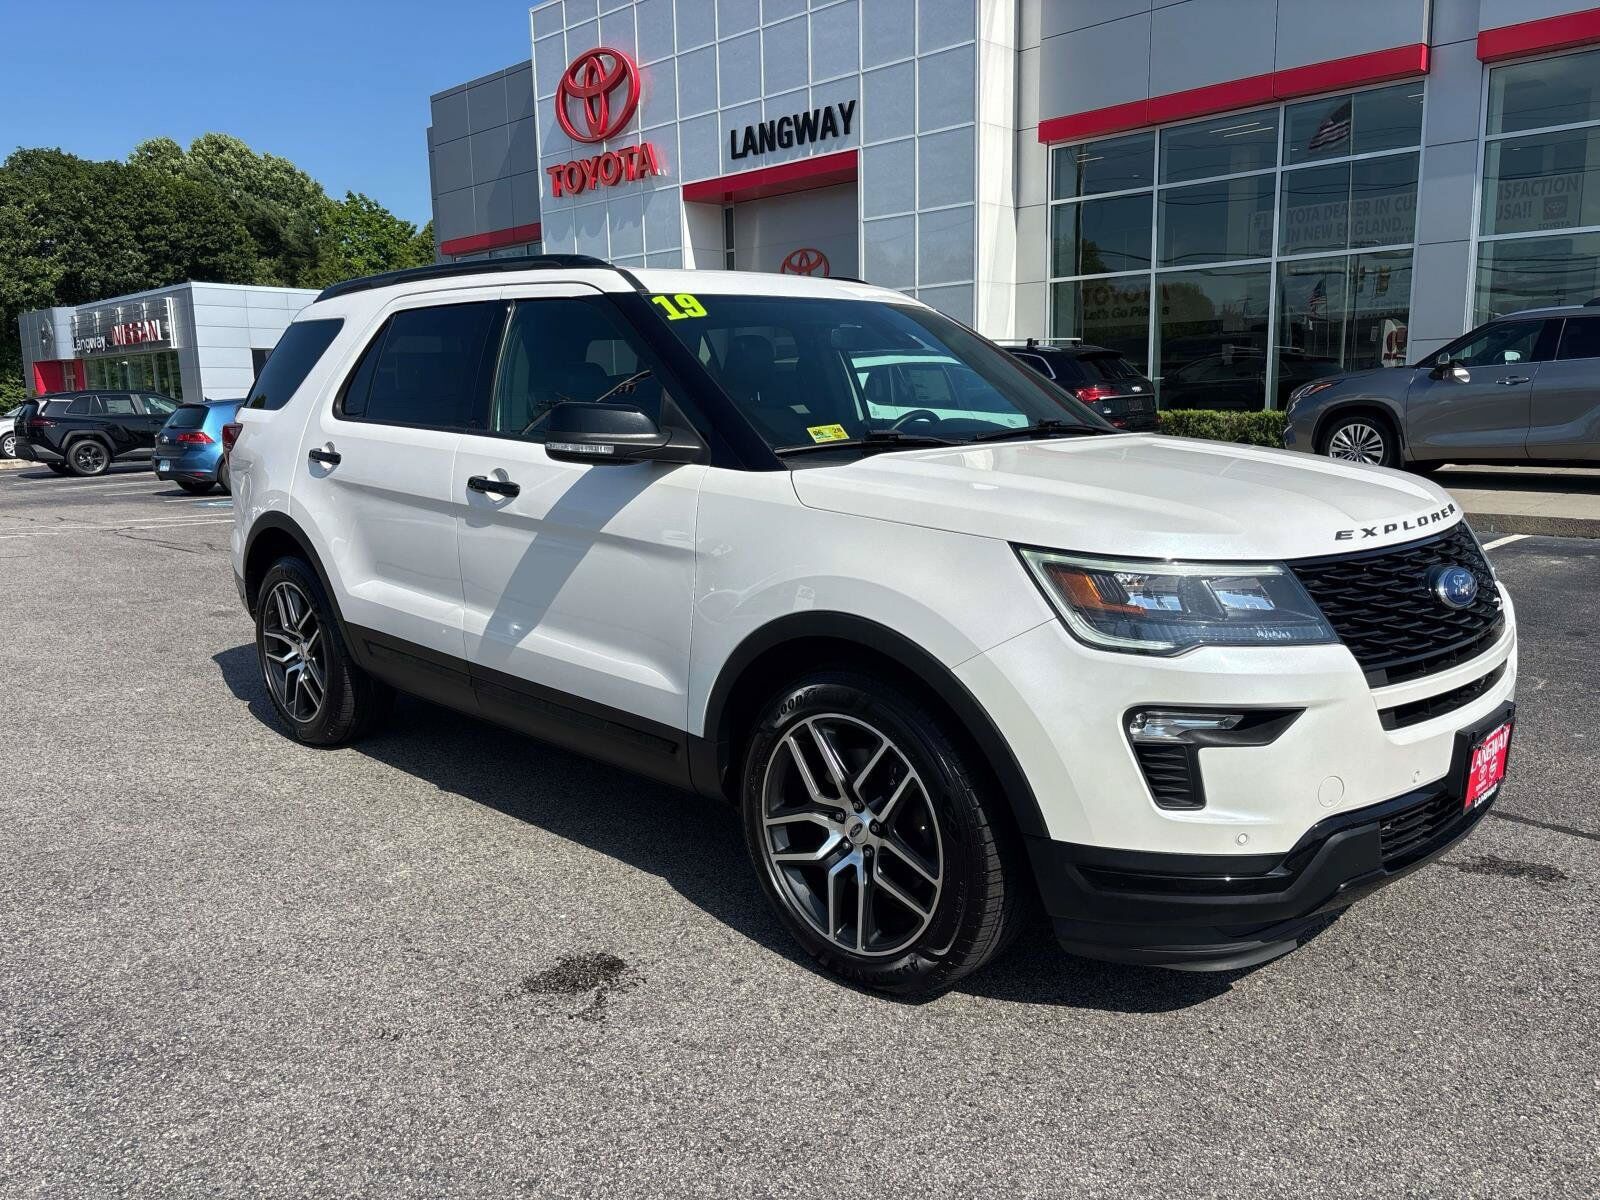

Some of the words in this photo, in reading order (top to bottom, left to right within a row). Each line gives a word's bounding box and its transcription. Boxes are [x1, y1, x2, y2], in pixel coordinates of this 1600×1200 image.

[730, 98, 857, 160] LANGWAY
[546, 142, 657, 198] TOYOTA
[1499, 175, 1579, 201] ISFACTION
[1287, 207, 1321, 225] YOTA
[1375, 199, 1390, 214] IN
[1395, 195, 1417, 212] CU
[1304, 222, 1333, 241] NEW
[651, 294, 708, 321] 19
[1082, 283, 1169, 306] TOYOT
[1111, 306, 1128, 319] Go
[1129, 305, 1170, 318] Plas
[72, 335, 106, 353] Langway
[112, 318, 162, 346] NISSAN
[1334, 503, 1456, 541] EXPLORER
[1470, 726, 1511, 775] LANGWAY
